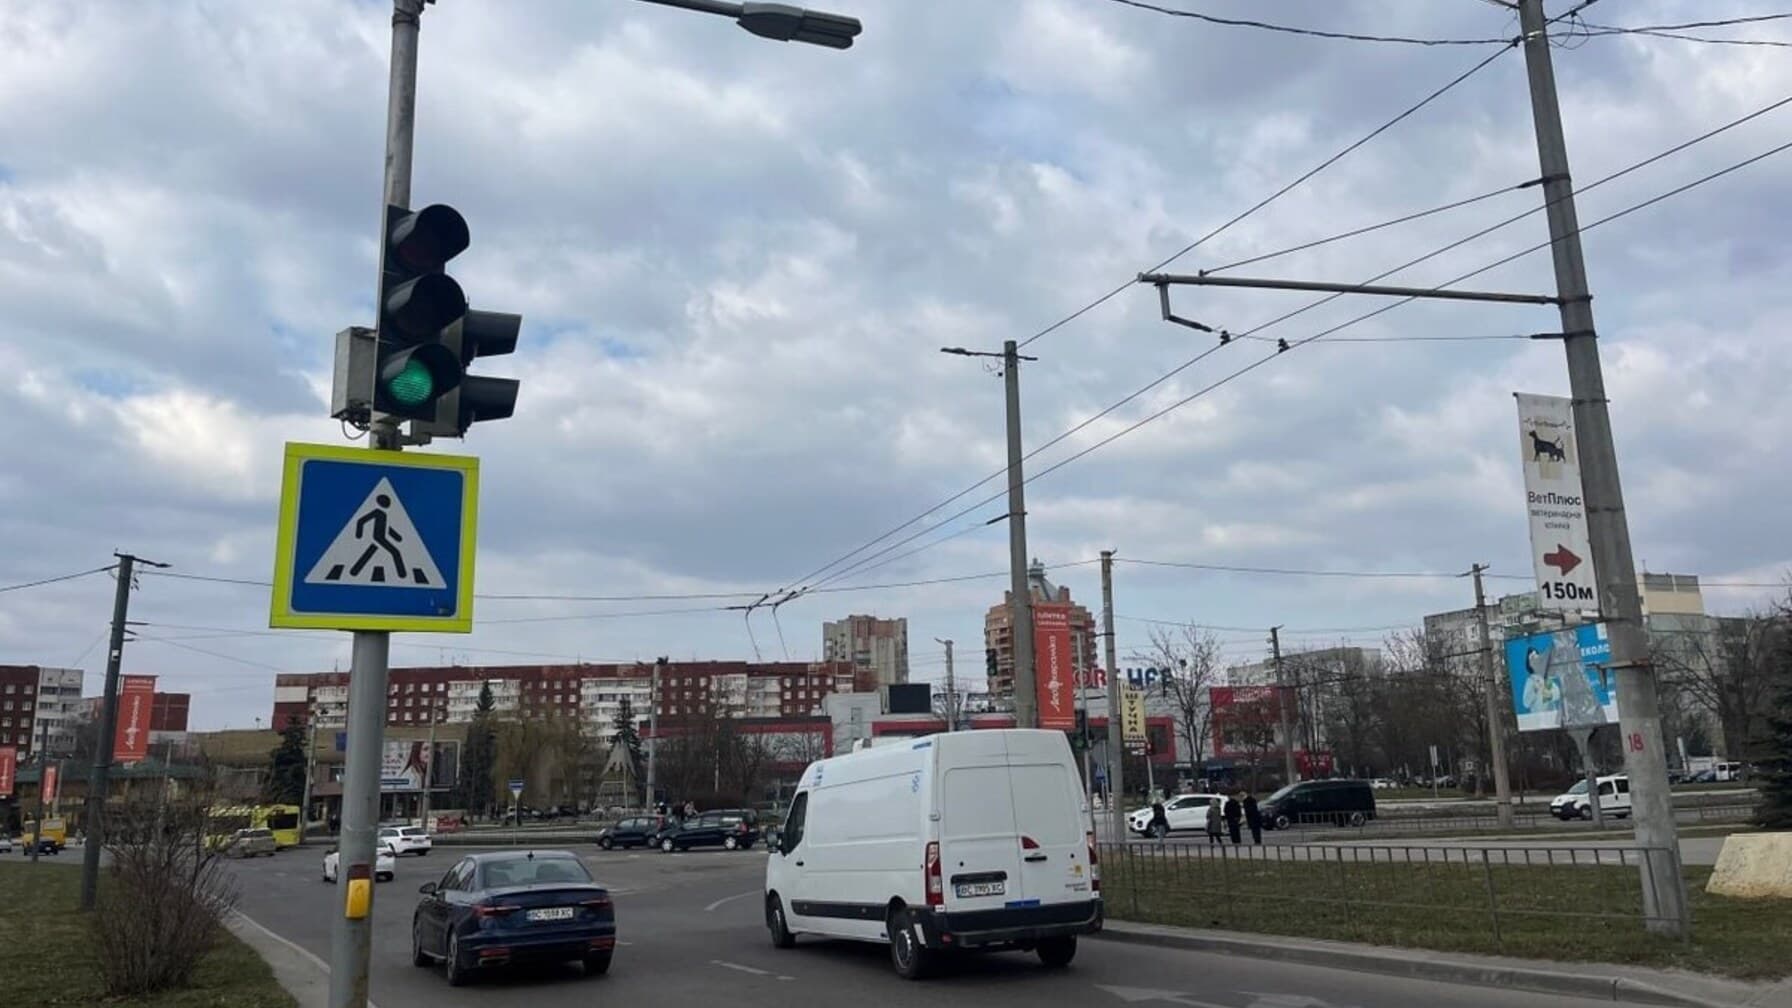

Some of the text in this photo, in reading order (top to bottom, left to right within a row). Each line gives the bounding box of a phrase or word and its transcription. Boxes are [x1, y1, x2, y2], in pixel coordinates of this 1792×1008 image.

[1527, 491, 1581, 506] ВетПлюс
[1541, 581, 1594, 600] 150м
[1628, 732, 1645, 753] 18
